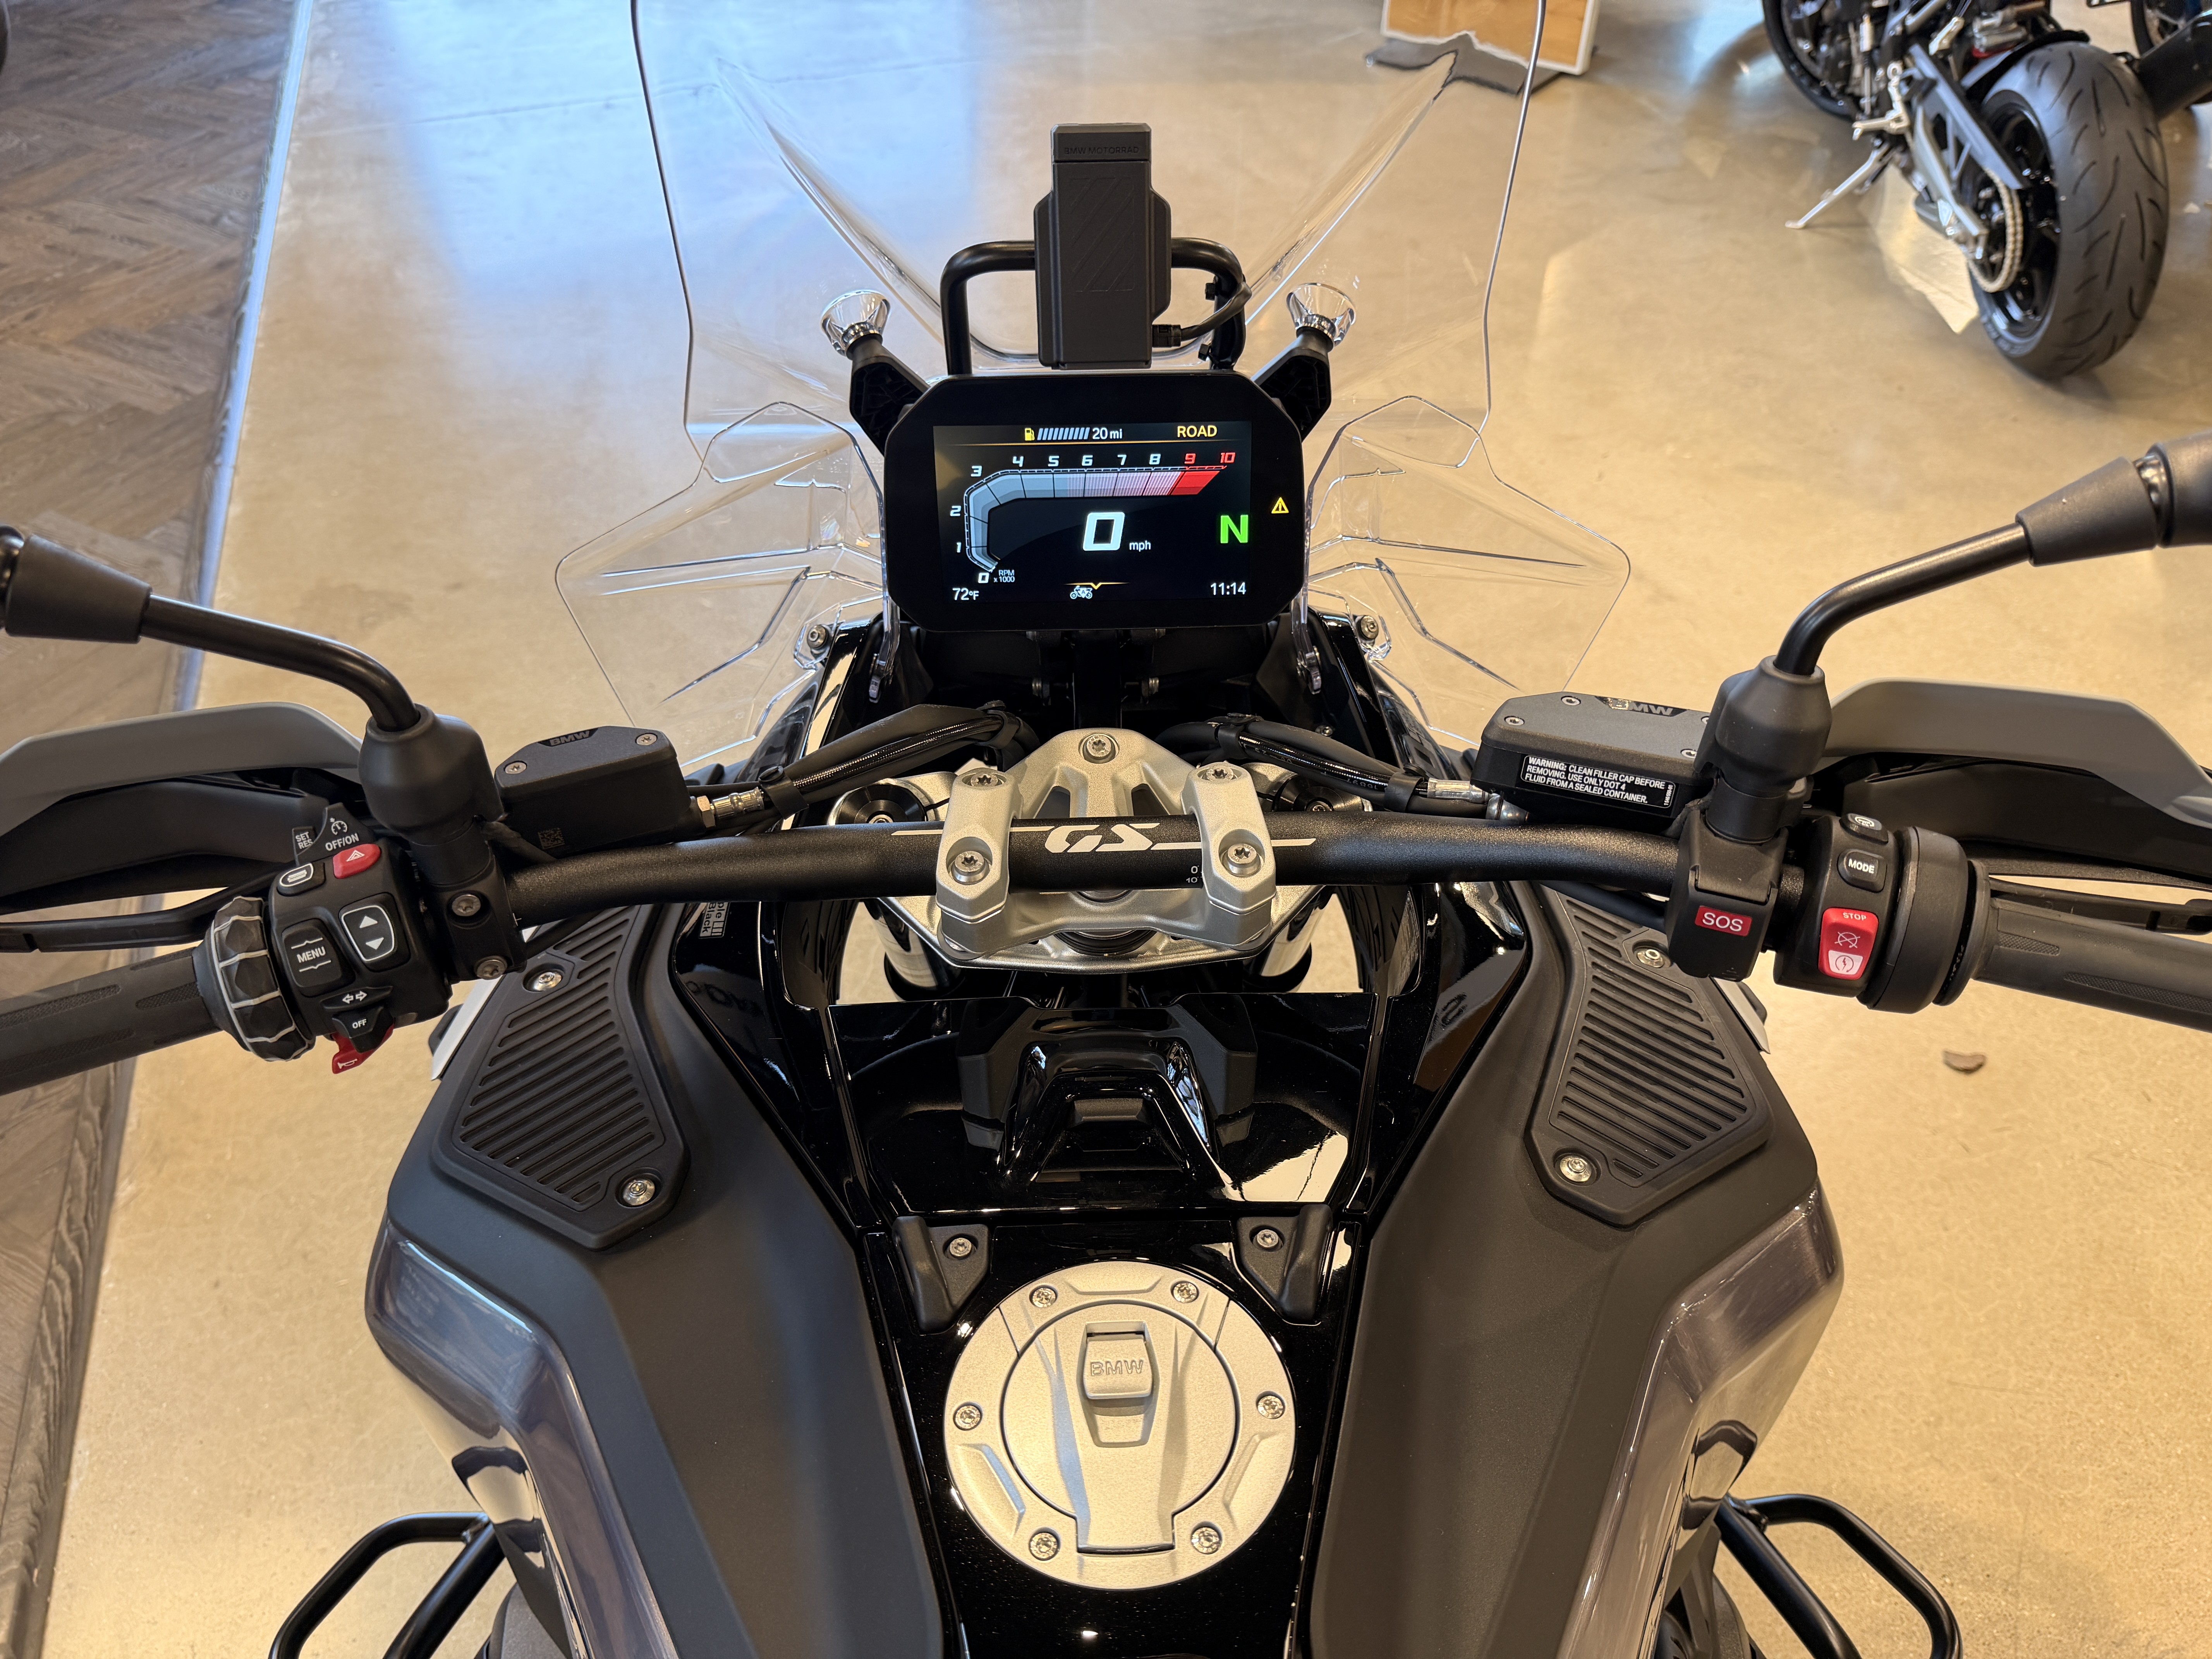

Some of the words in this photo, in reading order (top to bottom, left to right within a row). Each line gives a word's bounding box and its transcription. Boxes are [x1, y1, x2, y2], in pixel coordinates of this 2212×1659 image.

[1089, 146, 1139, 154] MOTORRAD
[1092, 428, 1108, 440] 20
[1109, 429, 1123, 439] mi
[1177, 425, 1218, 438] ROAD
[1012, 456, 1024, 467] 4
[1048, 455, 1060, 467] 5
[1082, 455, 1093, 466] 6
[1117, 454, 1127, 465] 7
[1149, 453, 1161, 465] 8
[1184, 453, 1196, 464] 9
[1220, 452, 1236, 464] 10
[970, 465, 982, 477] 3
[950, 505, 962, 517] 2
[1083, 512, 1125, 551] 0
[1129, 540, 1152, 552] mph
[1220, 514, 1249, 544] N
[957, 542, 962, 553] 1
[978, 572, 989, 583] 0
[1211, 582, 1246, 595] 11:14
[550, 731, 590, 746] BMW
[1527, 766, 1566, 780] REMOVING.
[1568, 774, 1582, 782] USE
[1583, 776, 1603, 787] ONLY
[1604, 781, 1620, 789] DOT
[1528, 757, 1567, 771] WARNING:
[1569, 765, 1593, 776] CLEAN
[1594, 770, 1619, 781] FILLER
[1619, 775, 1635, 783] CAP
[1635, 778, 1665, 789] BEFORE
[1525, 774, 1546, 783] FLUID
[1546, 778, 1568, 788] FROM
[1575, 783, 1603, 795] SEALED
[1604, 789, 1648, 804] CONTAINER.
[295, 831, 310, 842] SET
[298, 839, 313, 849] RES
[325, 833, 359, 851] OFF/ON
[1044, 823, 1160, 853] GS
[1848, 859, 1875, 874] MODE
[702, 903, 716, 933] Black
[1702, 912, 1743, 931] SOS
[1843, 912, 1867, 921] STOP
[297, 946, 326, 963] MENU
[352, 1019, 367, 1029] OFF
[1090, 1358, 1144, 1377] BMW
